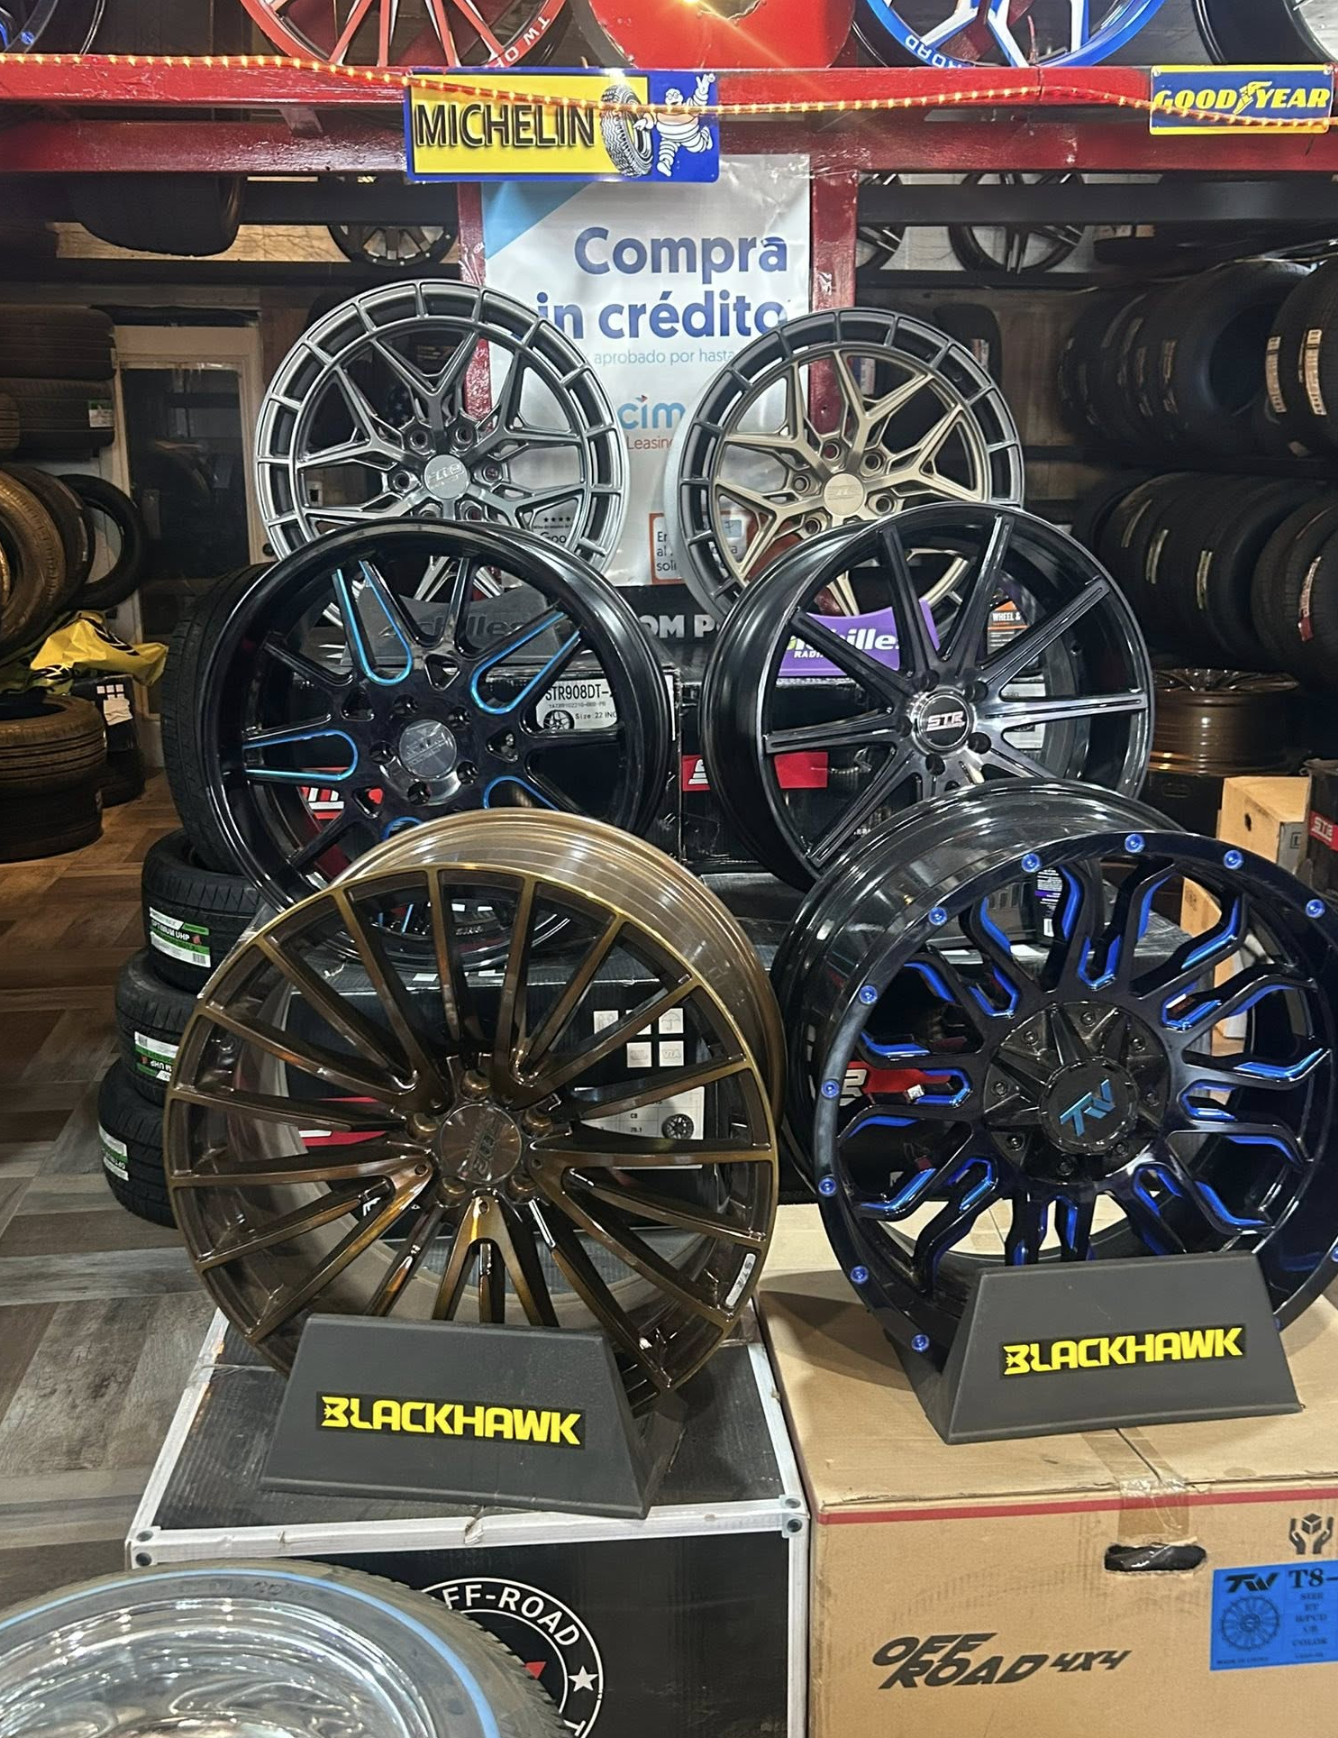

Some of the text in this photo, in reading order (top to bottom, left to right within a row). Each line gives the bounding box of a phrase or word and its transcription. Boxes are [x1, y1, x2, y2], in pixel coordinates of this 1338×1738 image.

[414, 103, 595, 147] MICHELIN
[574, 226, 788, 284] Compra
[536, 289, 788, 339] in crédito
[594, 350, 666, 366] aprobado
[670, 351, 695, 365] por
[927, 710, 965, 732] STR
[1003, 1327, 1243, 1375] BLACKHAWK
[321, 1396, 581, 1445] BLACKHAWK
[431, 1584, 580, 1646] FF-ROAD
[872, 1632, 998, 1666] OFF
[877, 1654, 1050, 1690] ROAD
